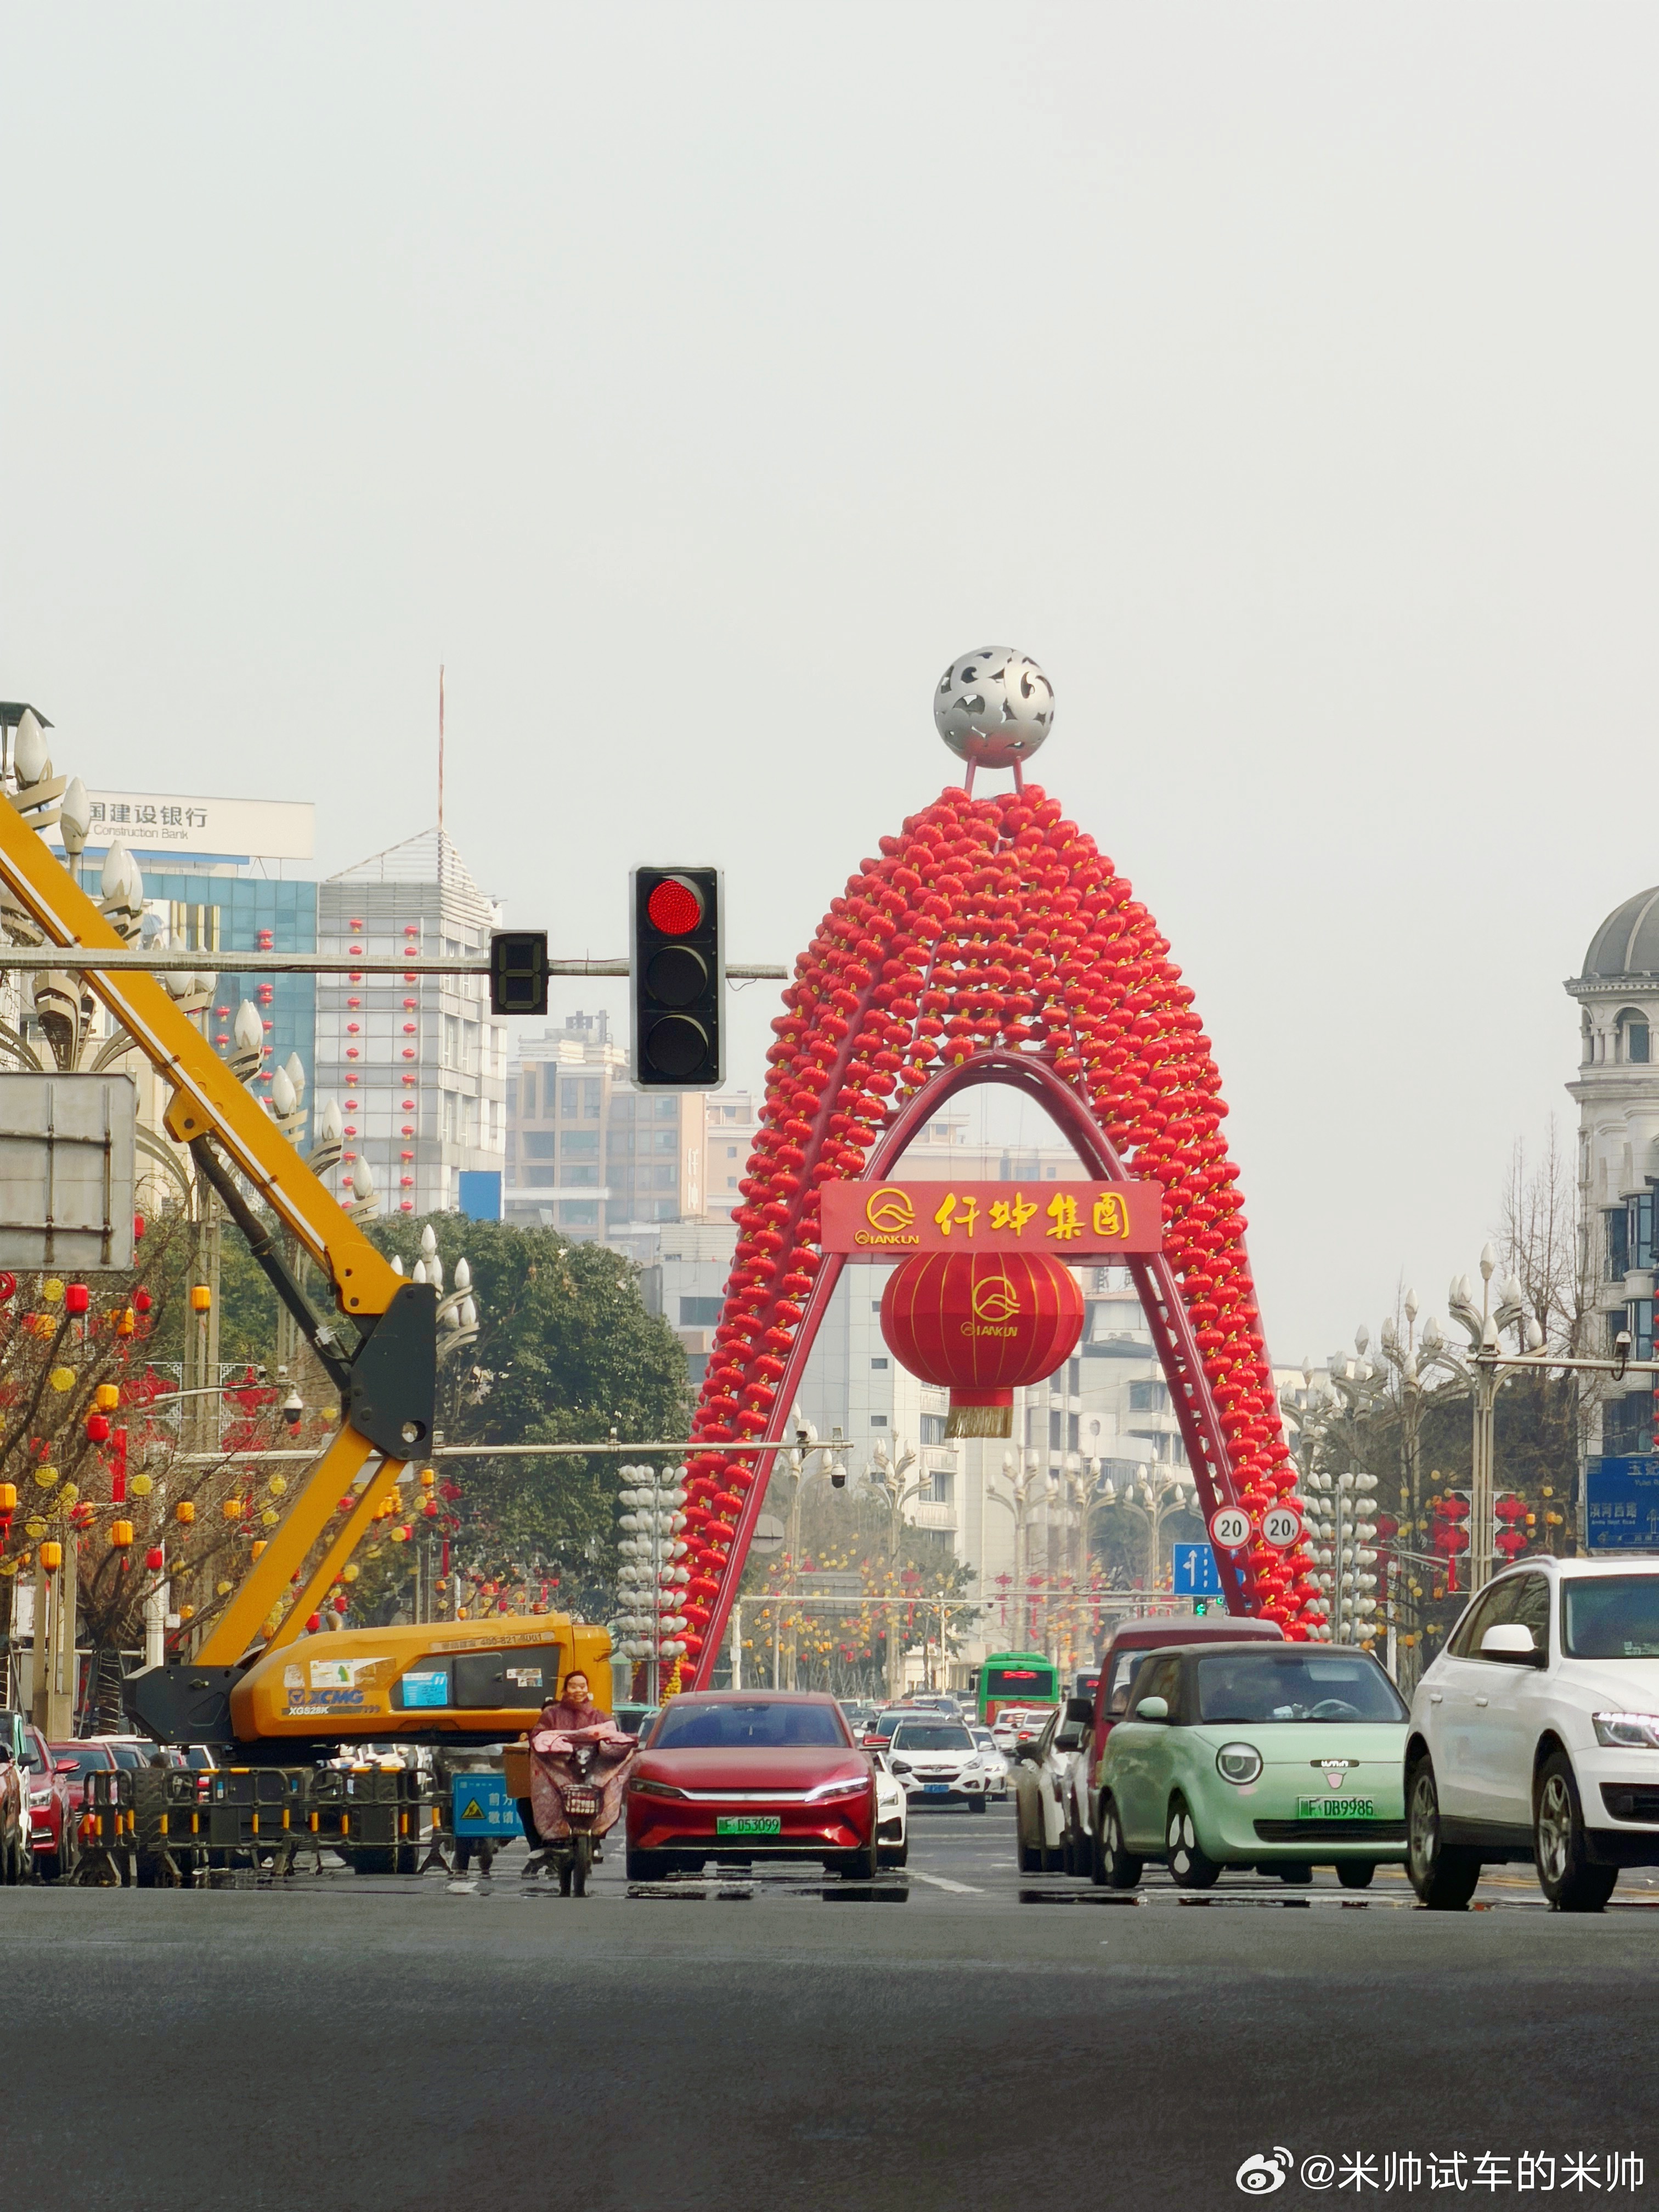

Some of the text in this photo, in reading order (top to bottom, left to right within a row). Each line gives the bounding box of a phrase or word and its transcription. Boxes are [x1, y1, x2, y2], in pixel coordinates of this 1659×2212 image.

[94, 824, 189, 840] Construction Bank
[1221, 1519, 1242, 1537] 20
[306, 1689, 364, 1706] XCMG
